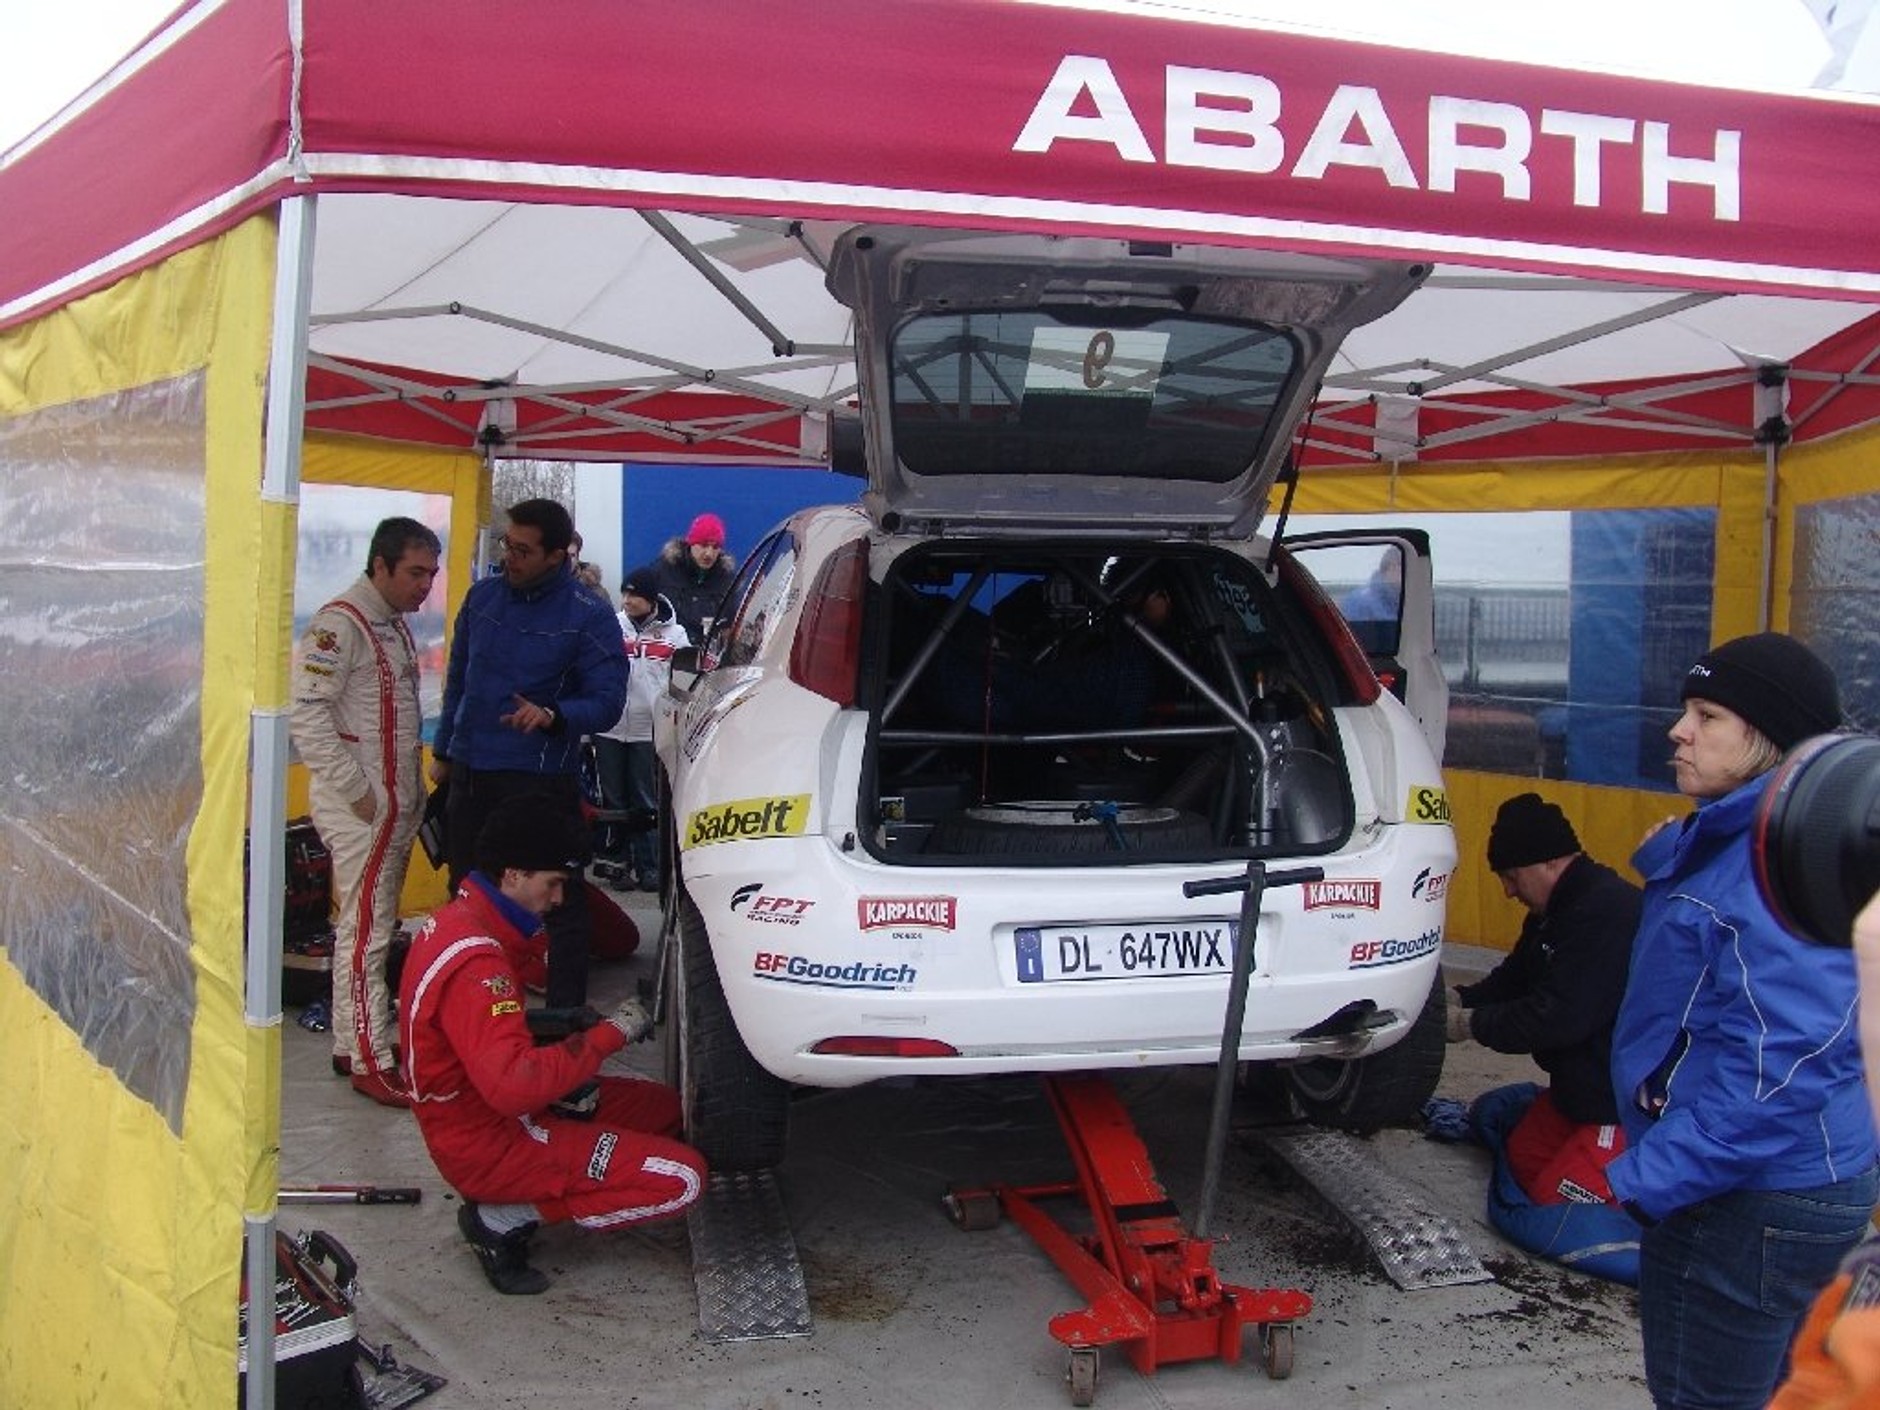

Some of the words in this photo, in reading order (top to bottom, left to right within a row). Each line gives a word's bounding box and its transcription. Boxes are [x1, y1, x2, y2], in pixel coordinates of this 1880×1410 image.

[1012, 54, 1741, 221] ABARTH
[1416, 789, 1451, 821] Sab
[691, 800, 794, 844] Sabelt
[752, 896, 816, 914] FPT
[1310, 883, 1376, 905] KARPACKIE
[866, 901, 949, 924] KARPACKIE
[1059, 935, 1103, 974] DL
[1120, 929, 1226, 971] 647WX
[754, 952, 917, 983] BFGoodrich
